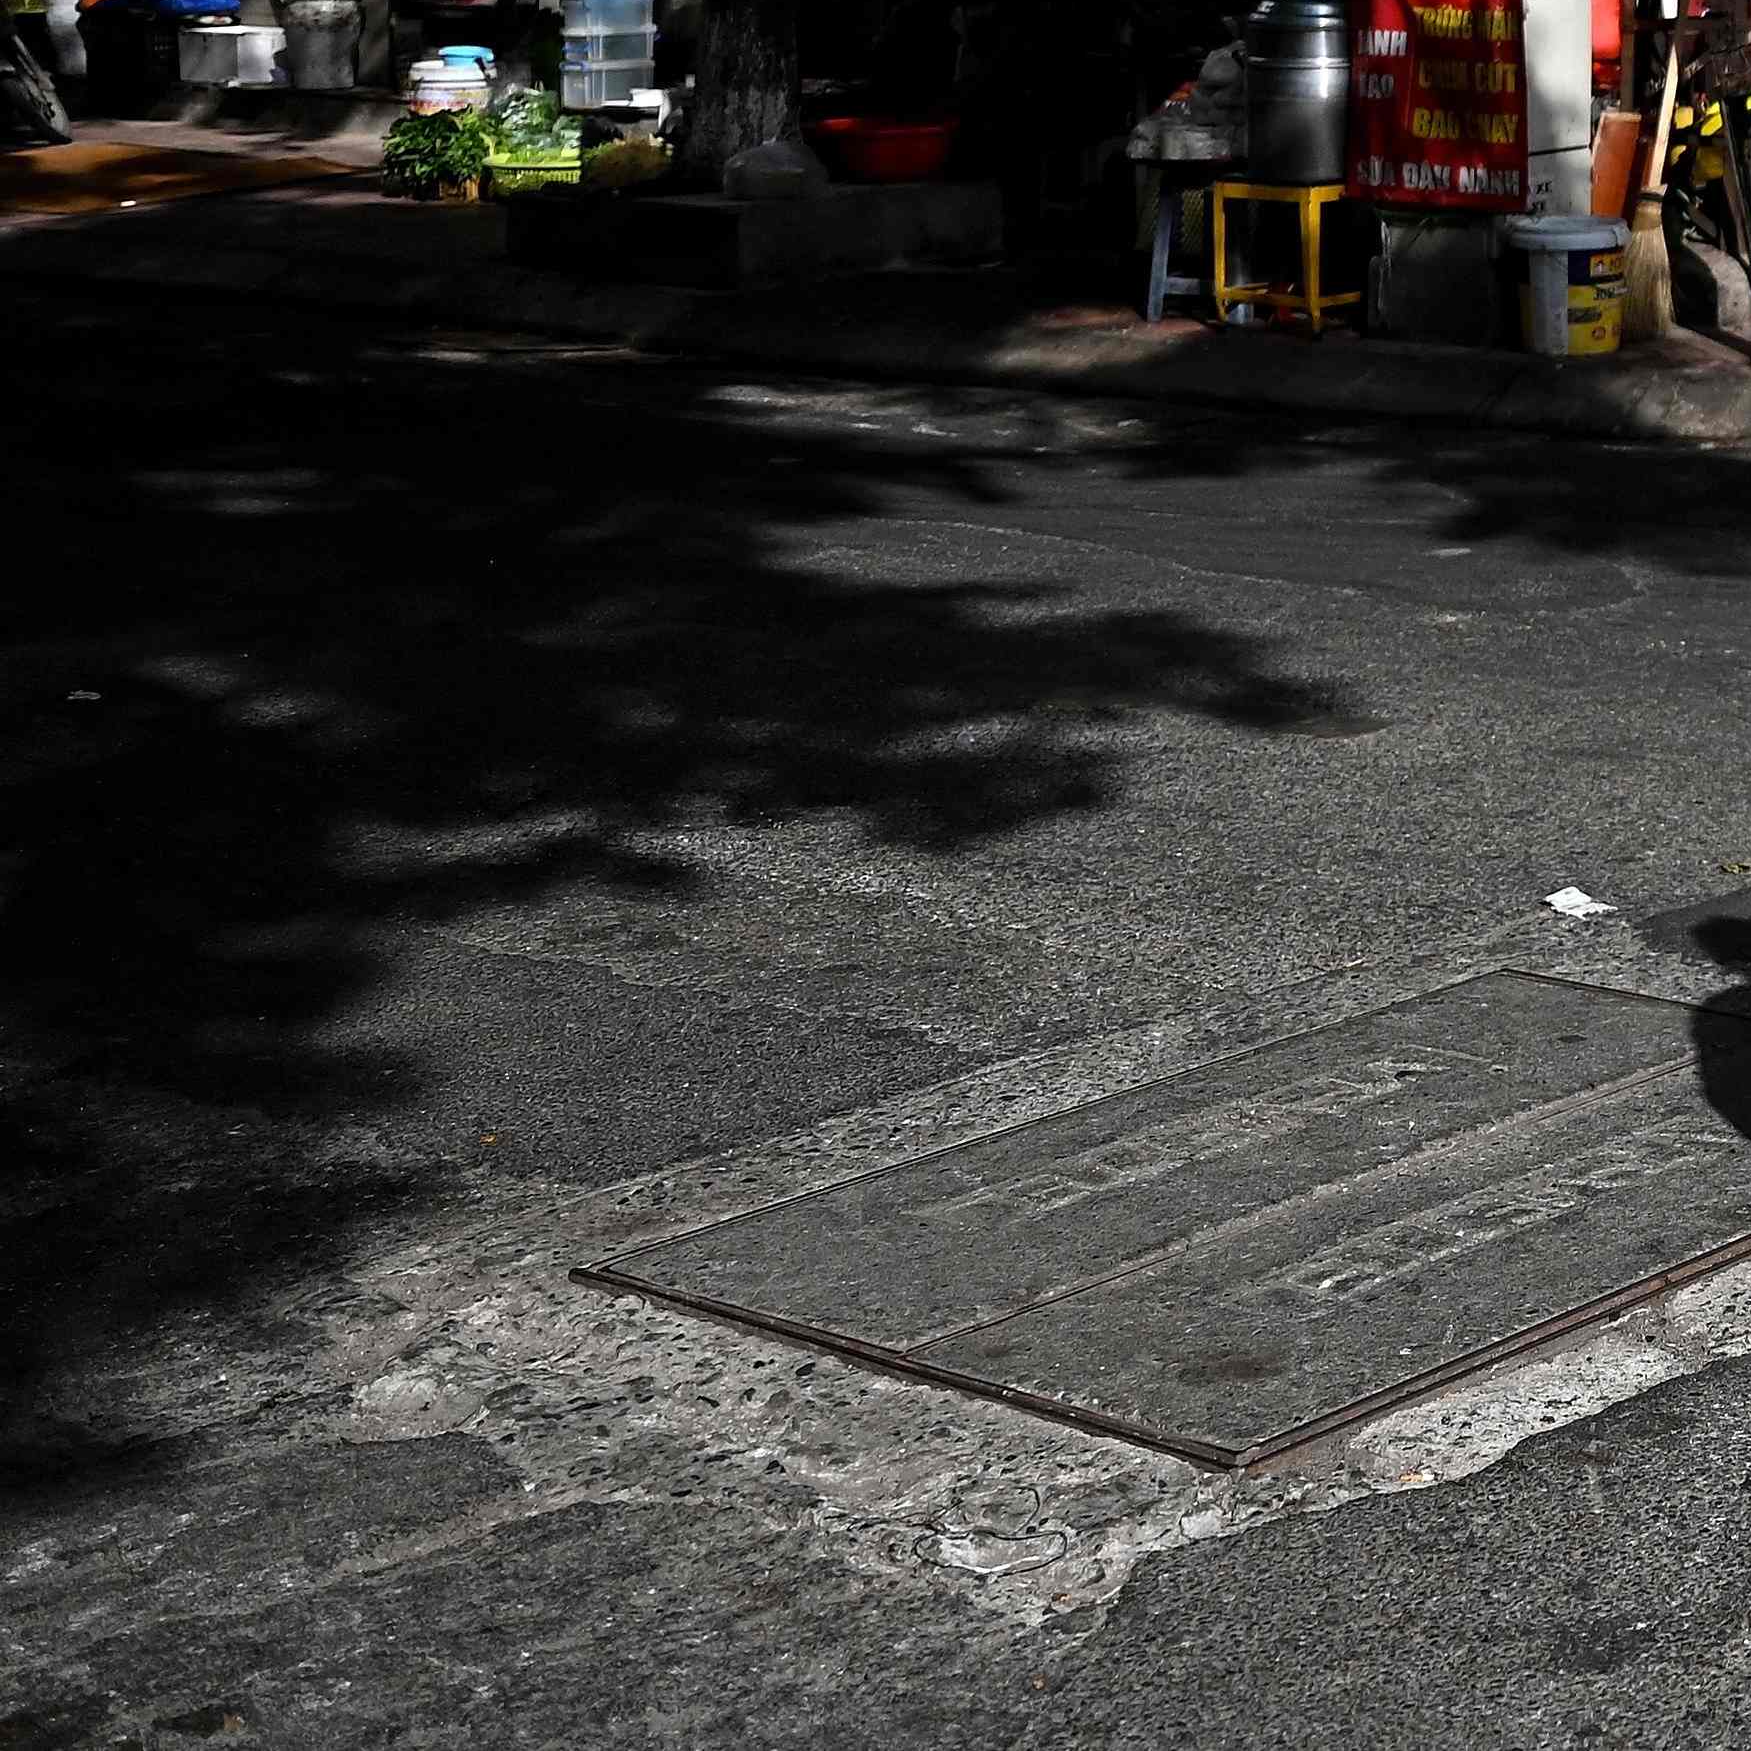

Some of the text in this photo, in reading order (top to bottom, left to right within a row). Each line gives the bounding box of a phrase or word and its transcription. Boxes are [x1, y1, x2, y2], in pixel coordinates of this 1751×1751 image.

[1411, 4, 1473, 41] TRỨNG
[1474, 56, 1519, 93] CÚT
[1402, 161, 1451, 192] ĐẬU
[1458, 164, 1521, 197] NÀNH
